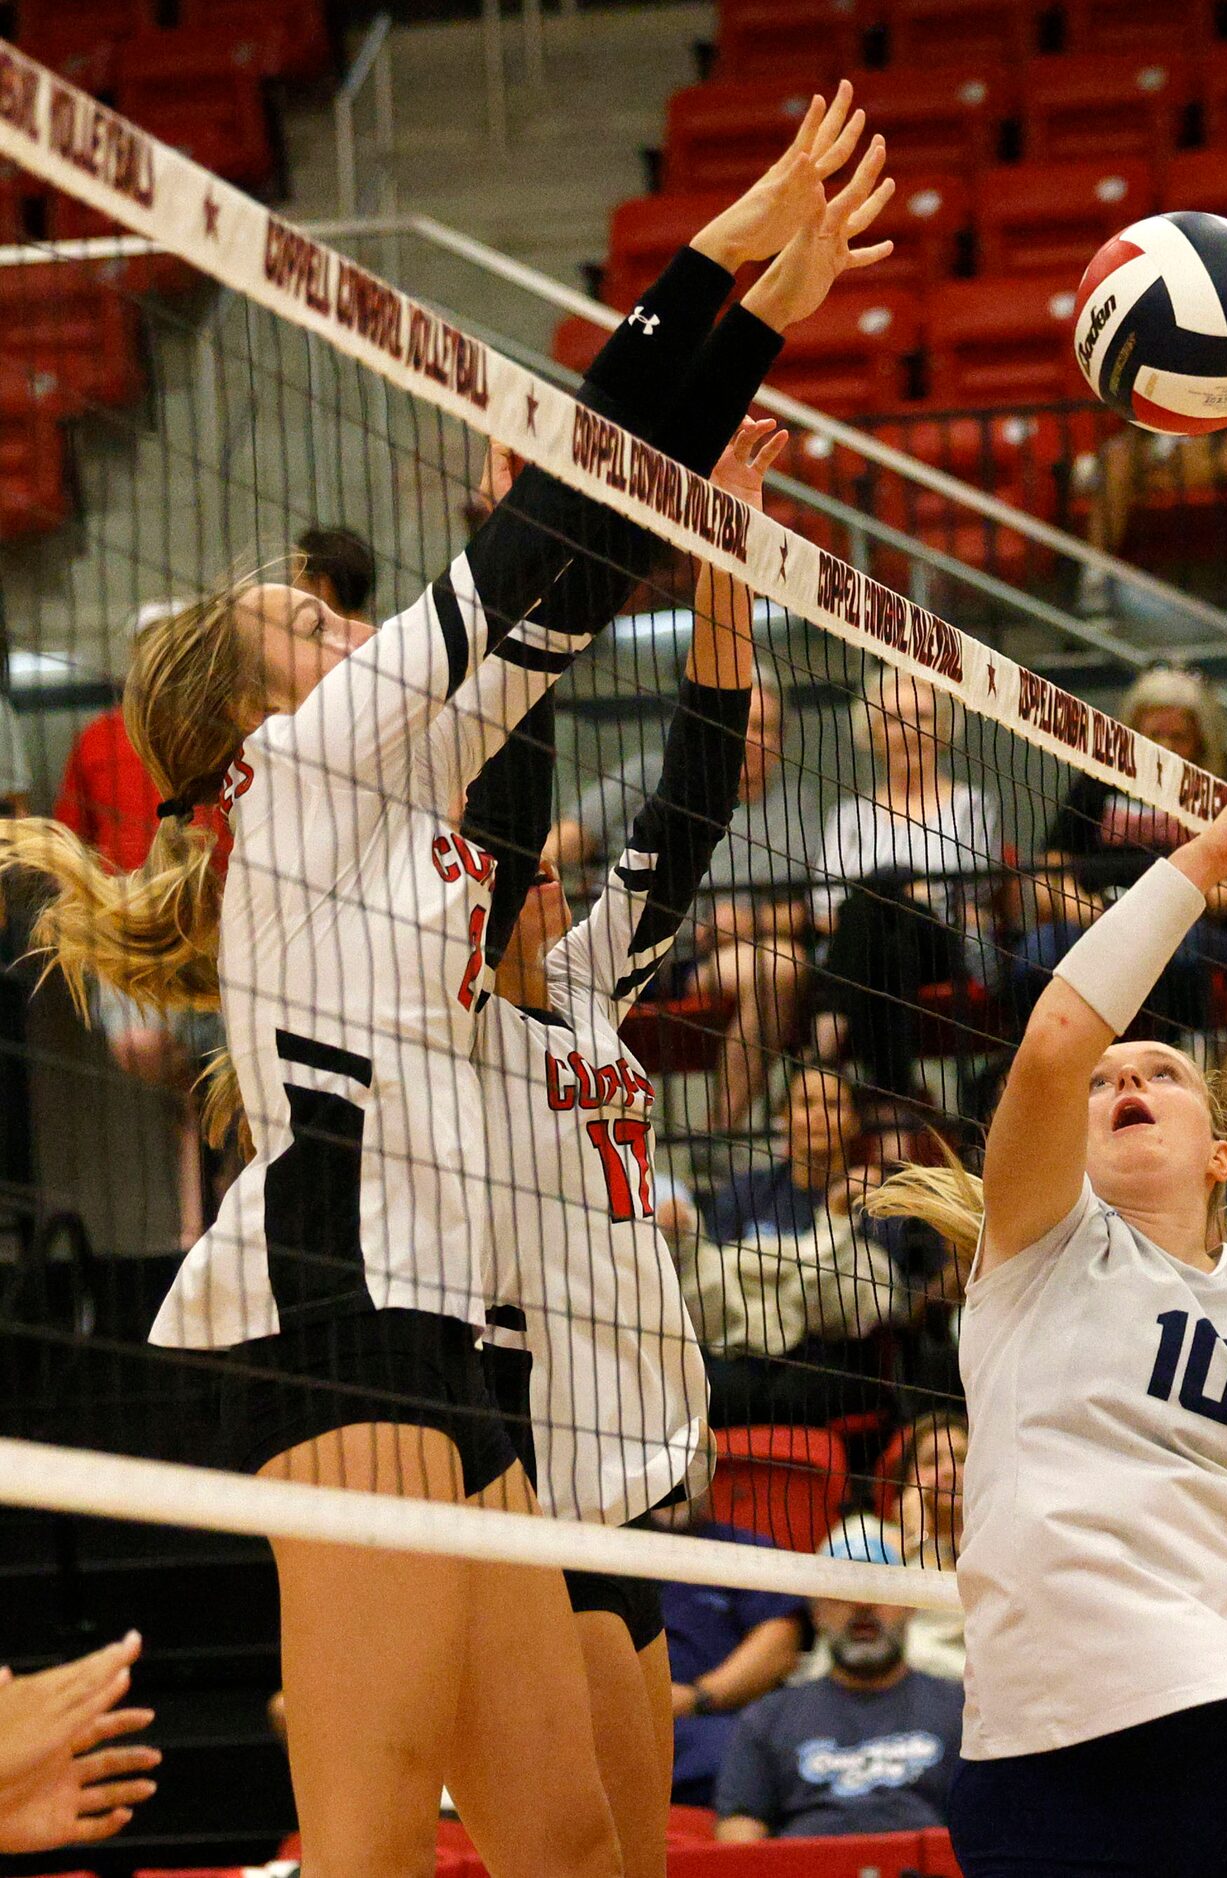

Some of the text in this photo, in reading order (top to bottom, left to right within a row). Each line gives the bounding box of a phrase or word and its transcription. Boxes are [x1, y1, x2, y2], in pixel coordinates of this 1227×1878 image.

[572, 404, 627, 492] COPPELL
[683, 464, 751, 564] VOLLEYBALL
[817, 550, 964, 684] COPPELL COWGIRL VOLLEYBALL
[586, 1118, 655, 1224] 17
